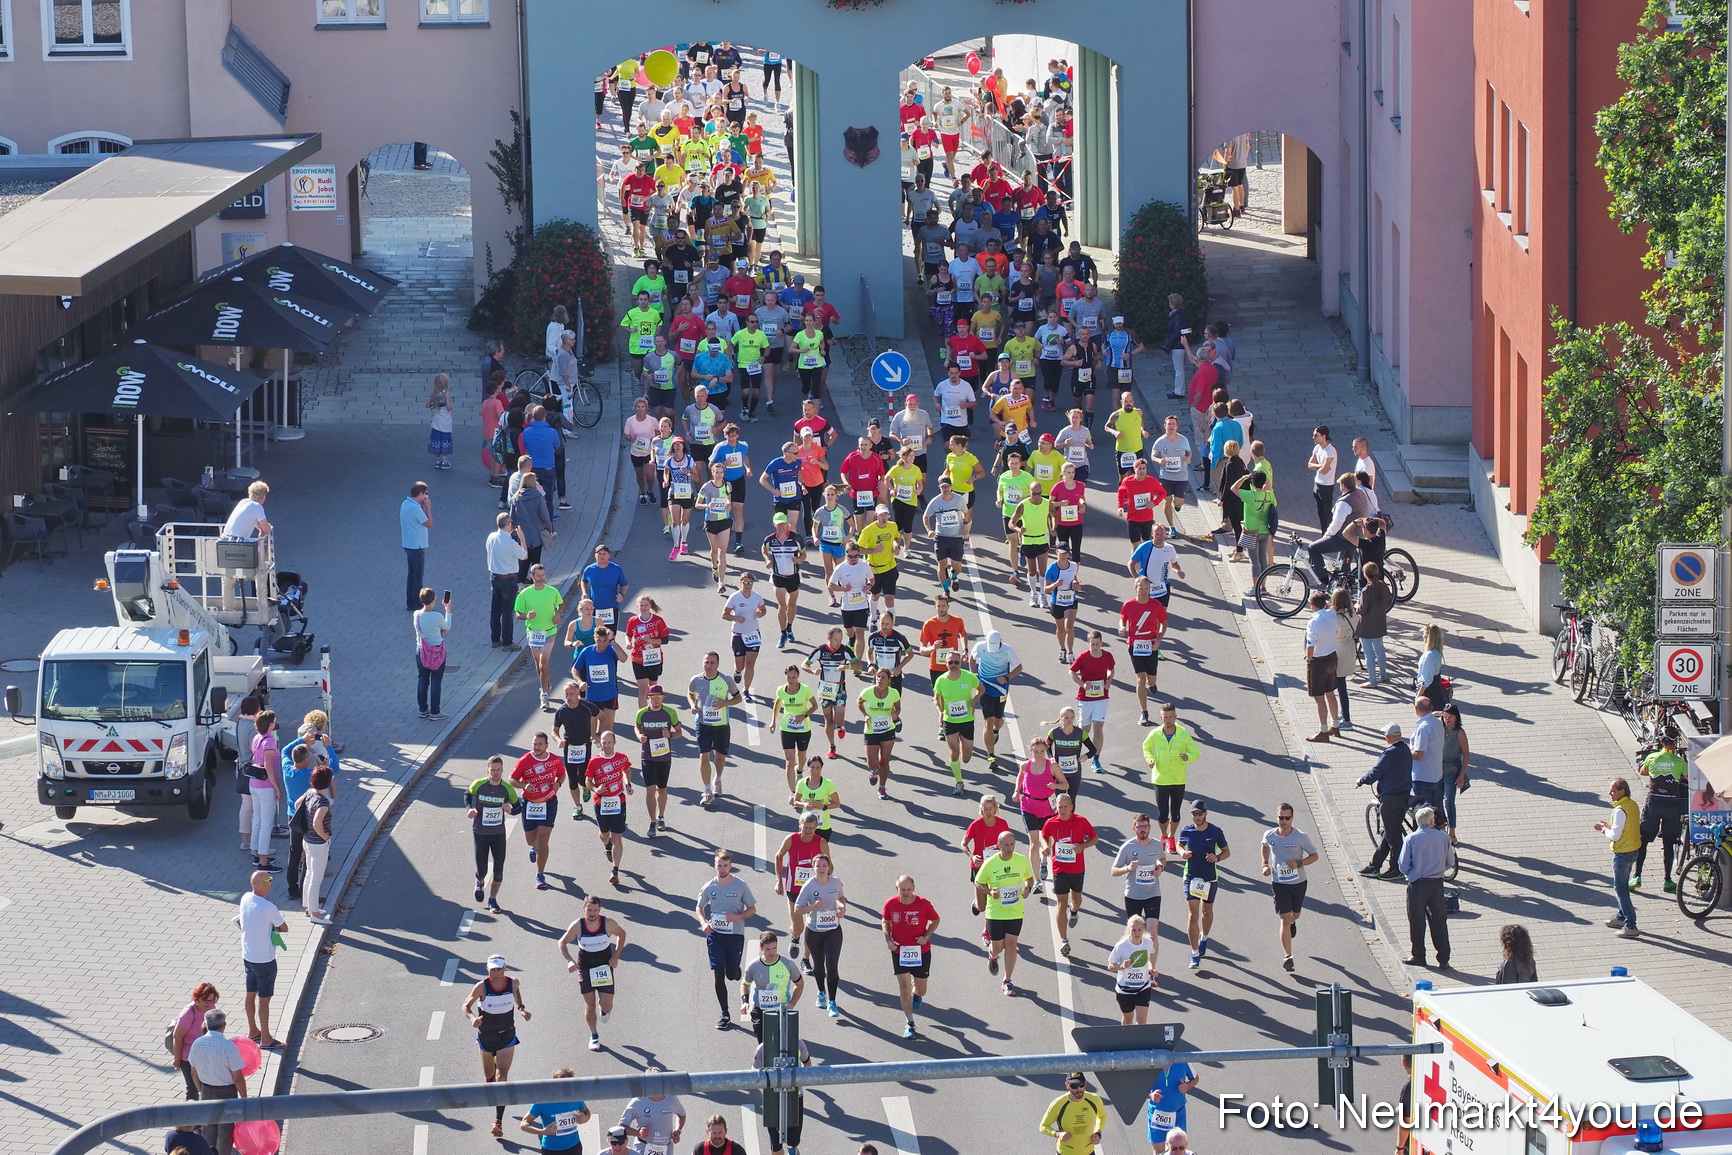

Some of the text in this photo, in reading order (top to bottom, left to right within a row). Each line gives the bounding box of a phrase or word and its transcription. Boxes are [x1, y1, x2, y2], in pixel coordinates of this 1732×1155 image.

[212, 306, 244, 338] now
[112, 370, 146, 406] now
[1674, 588, 1701, 597] ZONE
[1676, 658, 1696, 673] 30
[1672, 685, 1698, 693] ZONE
[478, 795, 505, 803] BOCK
[558, 1118, 576, 1126] 2610
[1156, 1114, 1171, 1124] 2601
